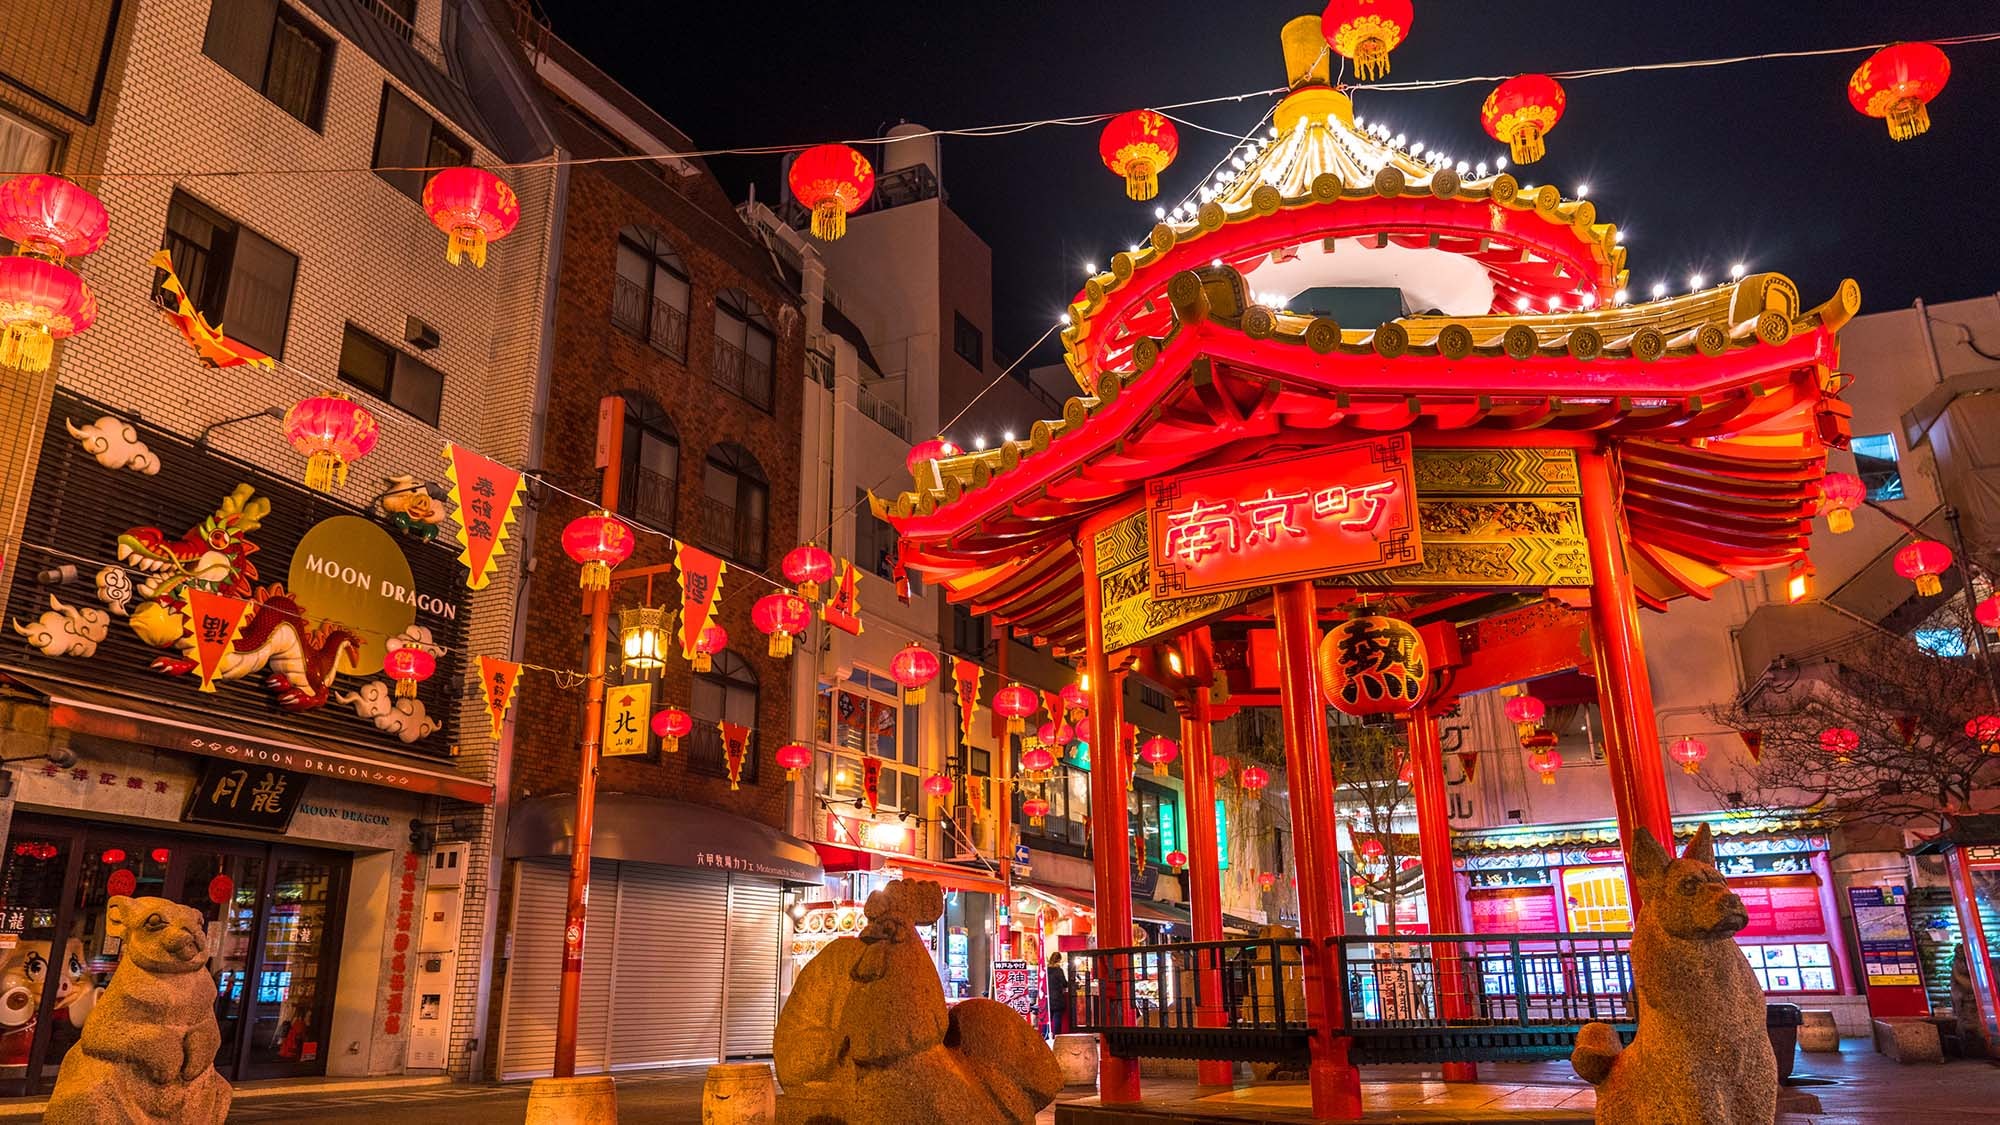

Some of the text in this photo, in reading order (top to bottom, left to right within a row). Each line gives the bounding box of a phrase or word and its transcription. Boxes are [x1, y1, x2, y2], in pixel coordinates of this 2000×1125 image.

[1165, 479, 1397, 562] 南京町
[306, 554, 457, 620] MOON DRAGON
[1338, 621, 1424, 704] 熱
[613, 710, 638, 734] 北
[244, 748, 368, 778] MOON DRAGON
[300, 803, 390, 826] MOON DRAGON
